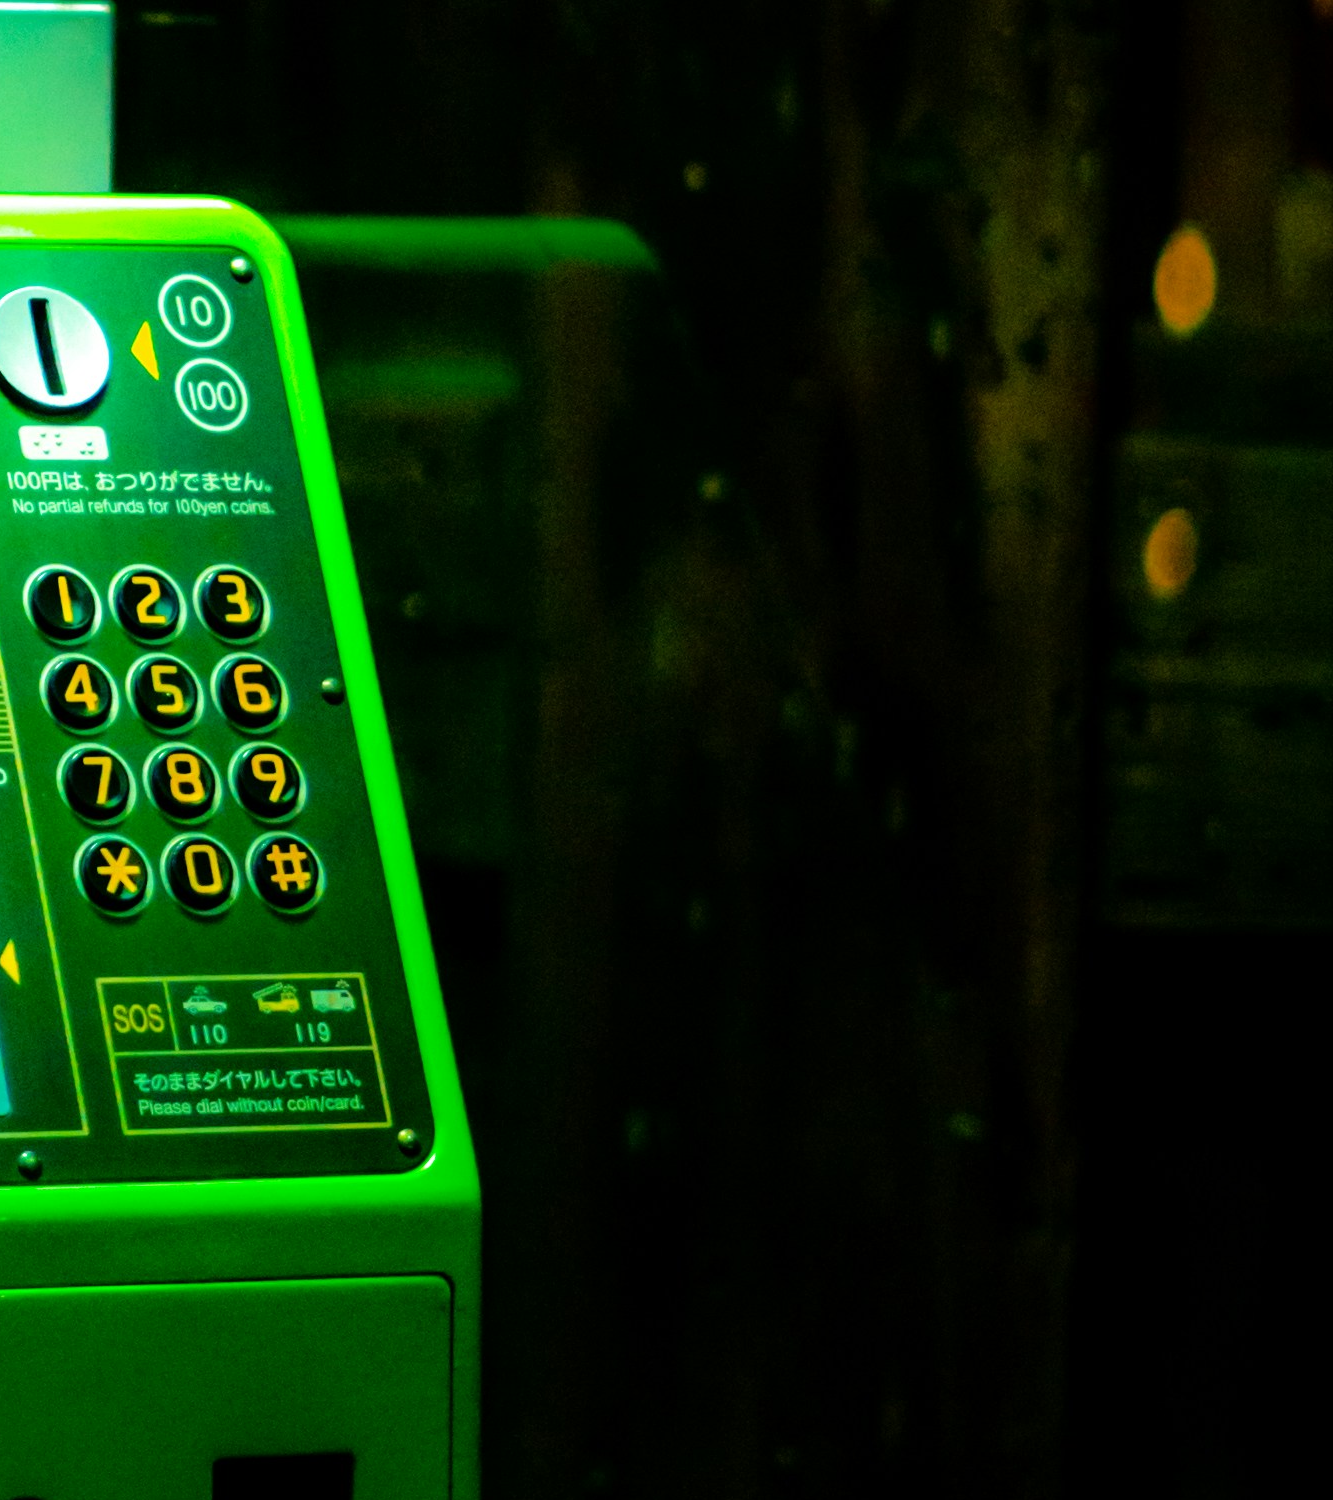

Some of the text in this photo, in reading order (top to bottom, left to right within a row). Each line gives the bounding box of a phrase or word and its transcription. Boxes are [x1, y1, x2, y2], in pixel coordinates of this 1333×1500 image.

[176, 295, 212, 327] 10
[188, 380, 237, 411] 100
[7, 471, 273, 493] 100円は、おつりがでません。
[13, 498, 275, 516] No partial refunds for 100yen coins.
[57, 574, 253, 624] 1 2 3
[64, 664, 272, 713] 4 5 6
[83, 753, 286, 804] 7 8 9
[184, 844, 224, 894] 0
[266, 844, 311, 891] #
[112, 1003, 331, 1045] SOS 110 119
[133, 1068, 362, 1092] そのままダイヤルして下さい。
[138, 1093, 365, 1116] Please dial without coin/card.
